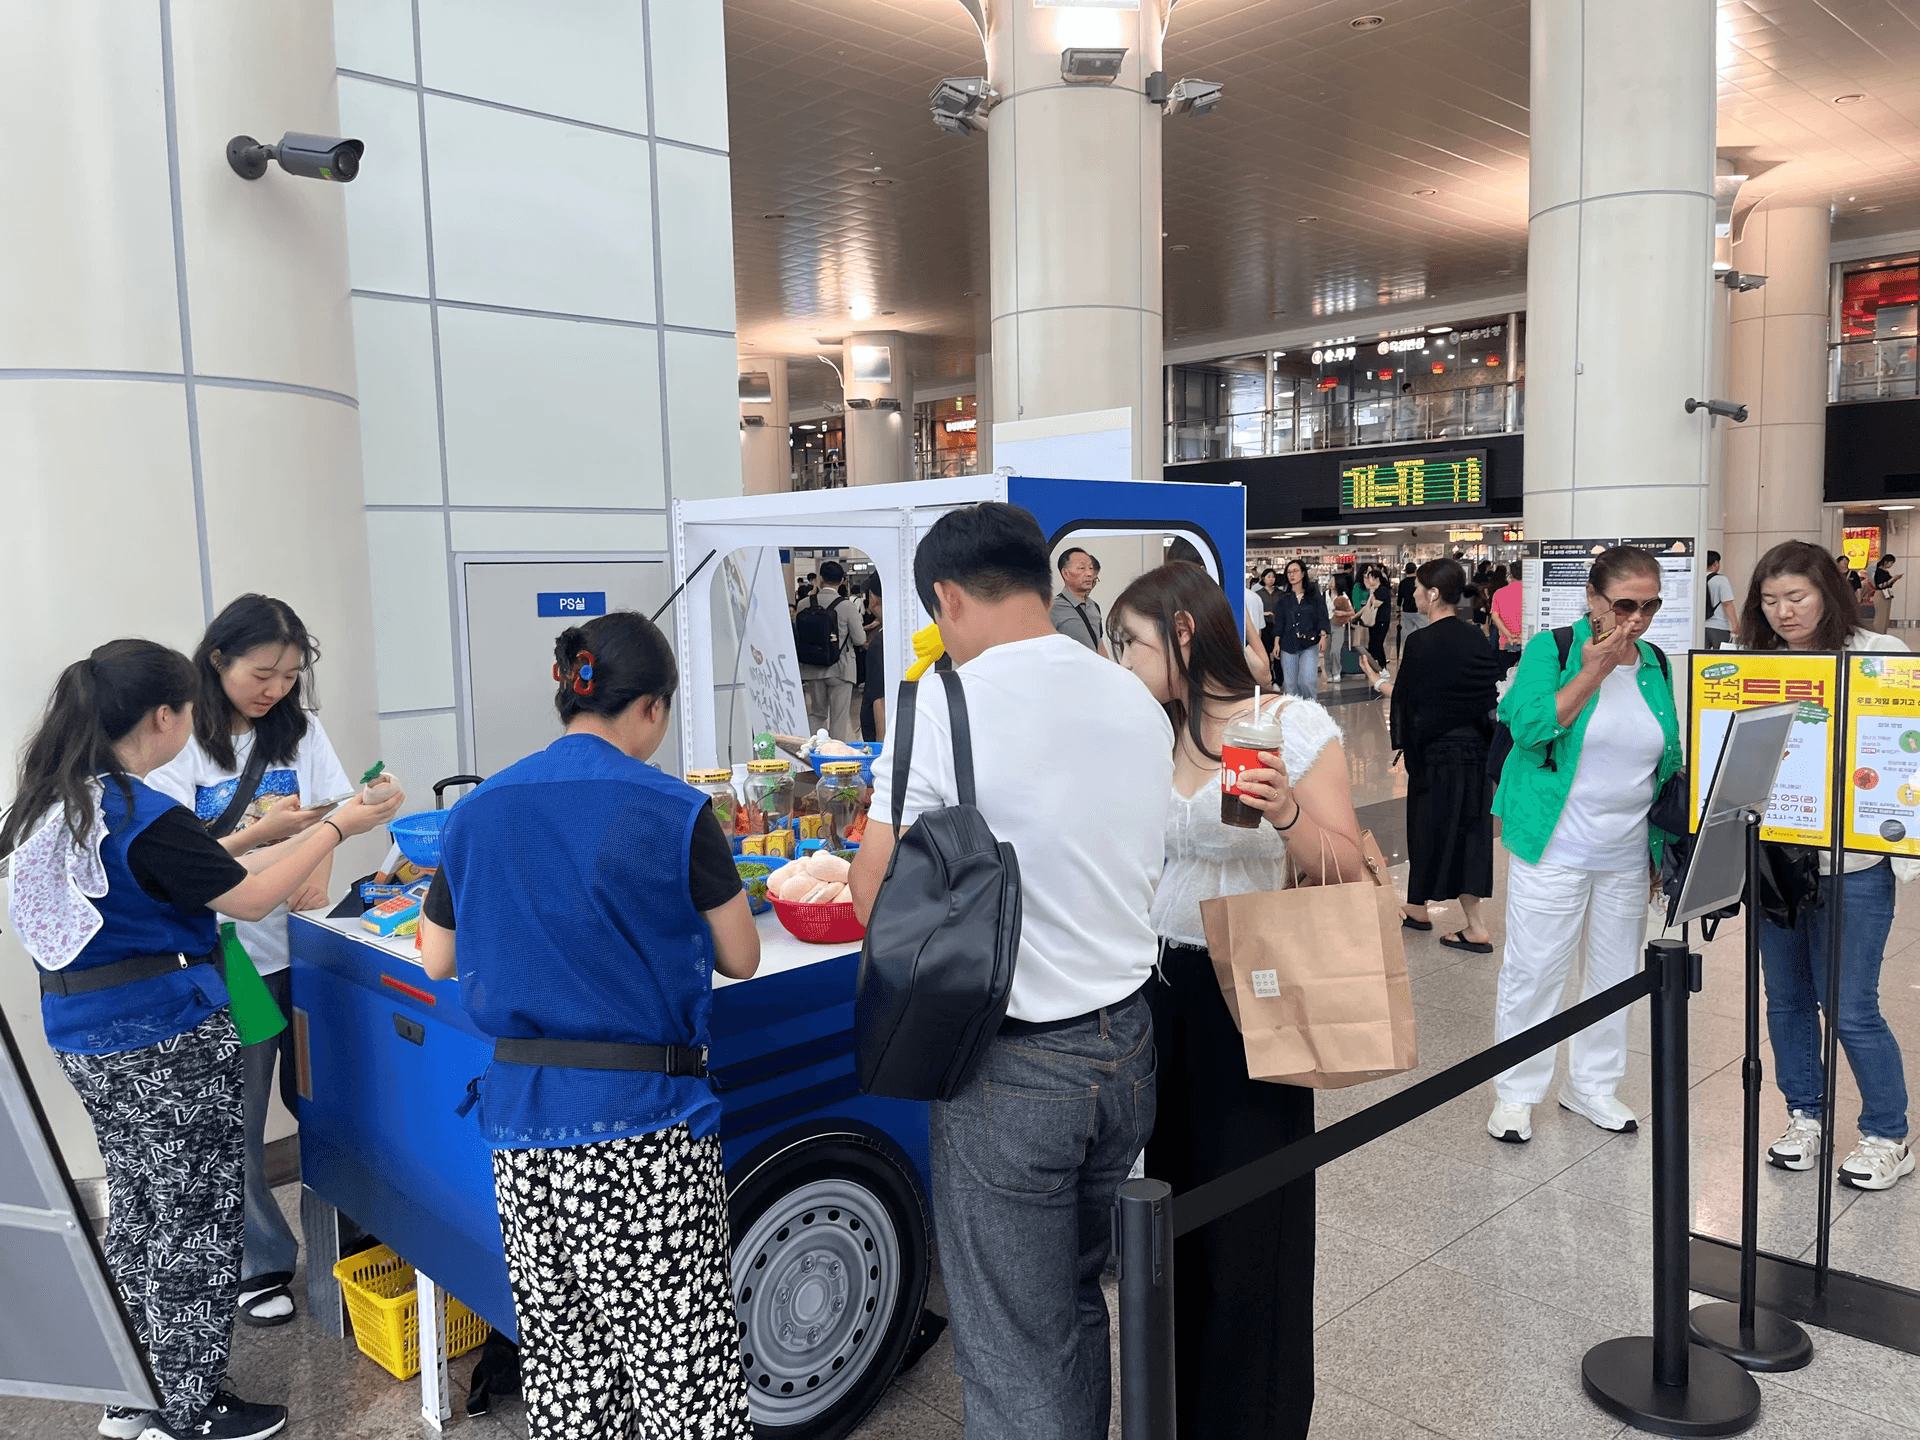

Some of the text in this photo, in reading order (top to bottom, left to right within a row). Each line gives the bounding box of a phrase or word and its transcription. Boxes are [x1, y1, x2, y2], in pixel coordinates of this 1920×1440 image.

[559, 597, 585, 611] PS실
[1703, 677, 1741, 691] 구석
[1703, 691, 1740, 705] 구석
[1874, 697, 1890, 705] 게임
[1892, 698, 1915, 706] 즐기고
[1257, 987, 1277, 995] daiso
[150, 1067, 174, 1082] UP
[166, 1139, 187, 1153] UP
